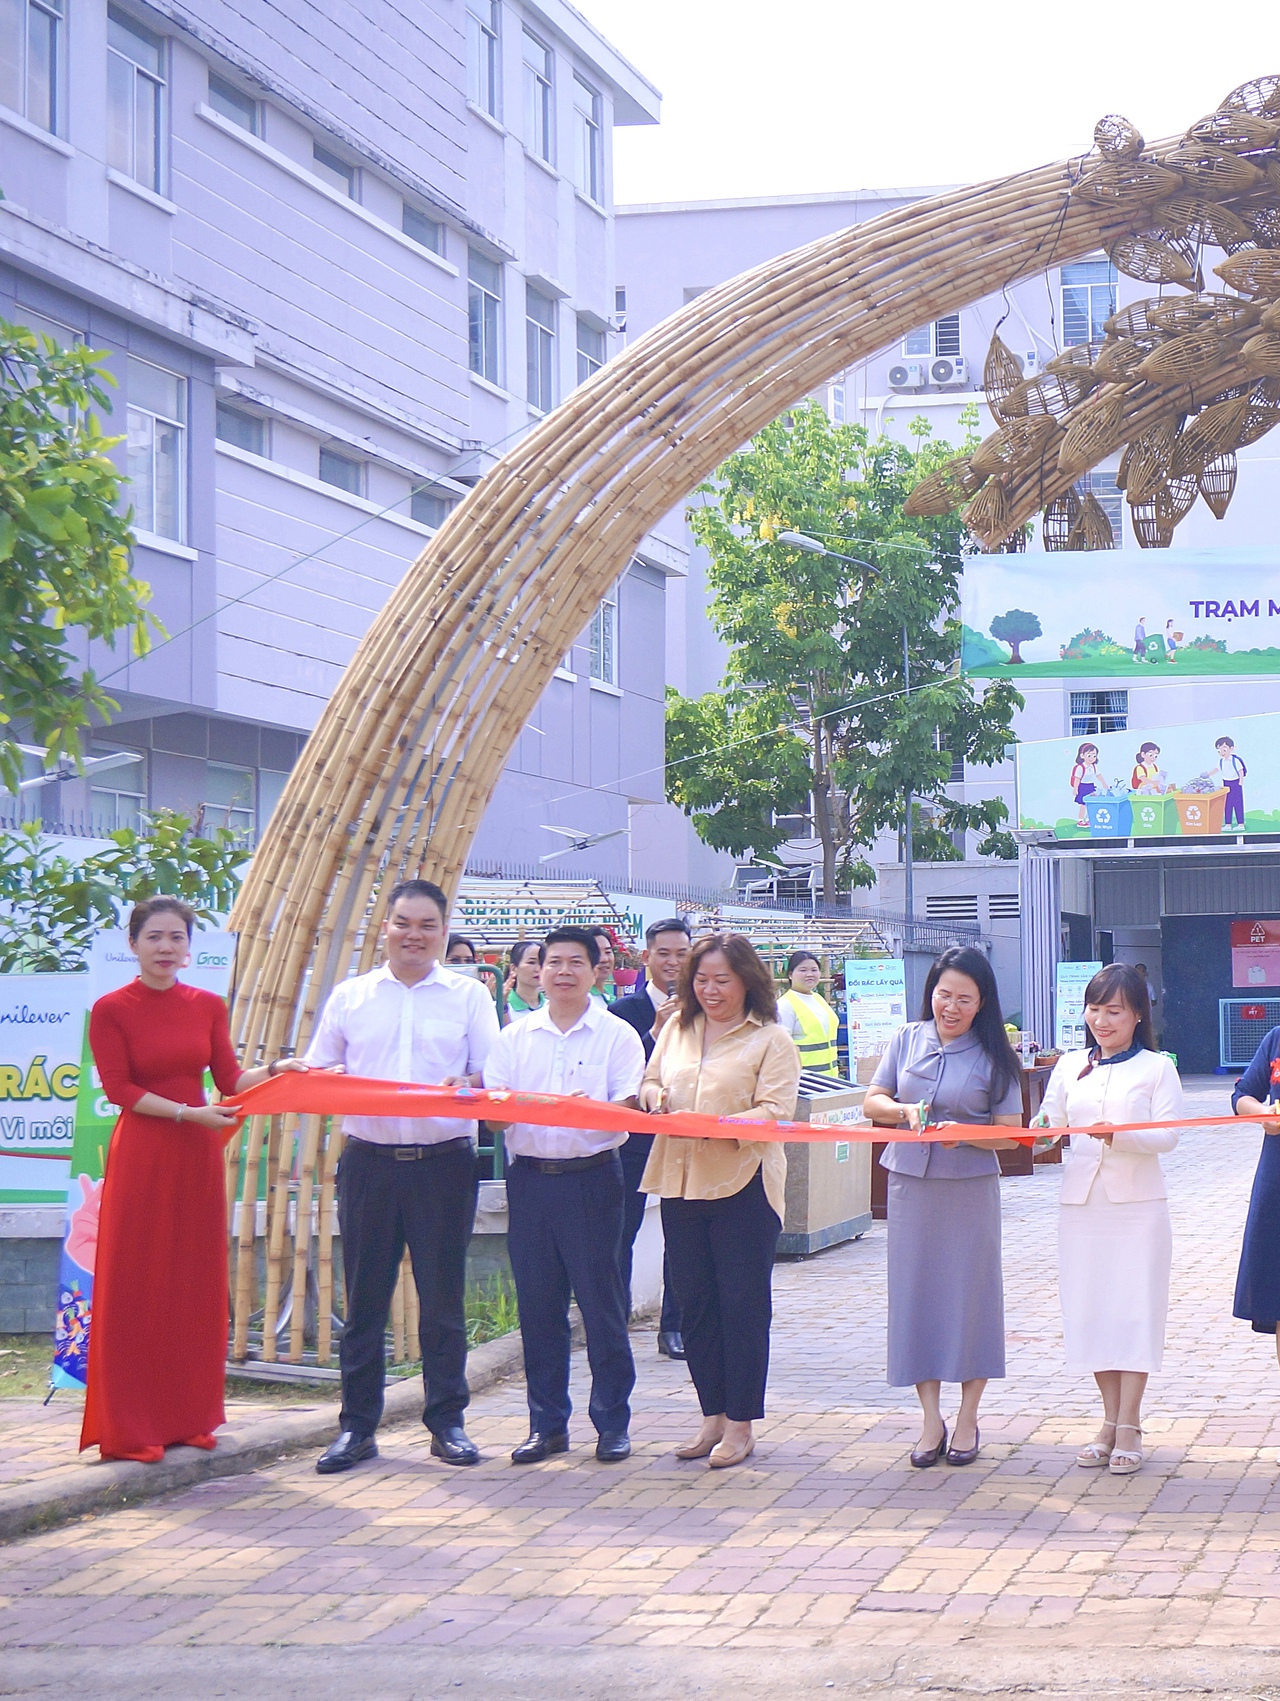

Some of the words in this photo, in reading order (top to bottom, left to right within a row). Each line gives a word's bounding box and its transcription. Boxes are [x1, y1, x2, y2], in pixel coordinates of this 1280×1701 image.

[1190, 599, 1260, 622] TRẠM
[197, 951, 228, 966] Grac
[848, 979, 860, 987] ĐỔI
[889, 978, 904, 986] QUÀ
[0, 1055, 80, 1101] RÁC
[1, 1117, 25, 1140] Vì
[31, 1116, 73, 1140] môi
